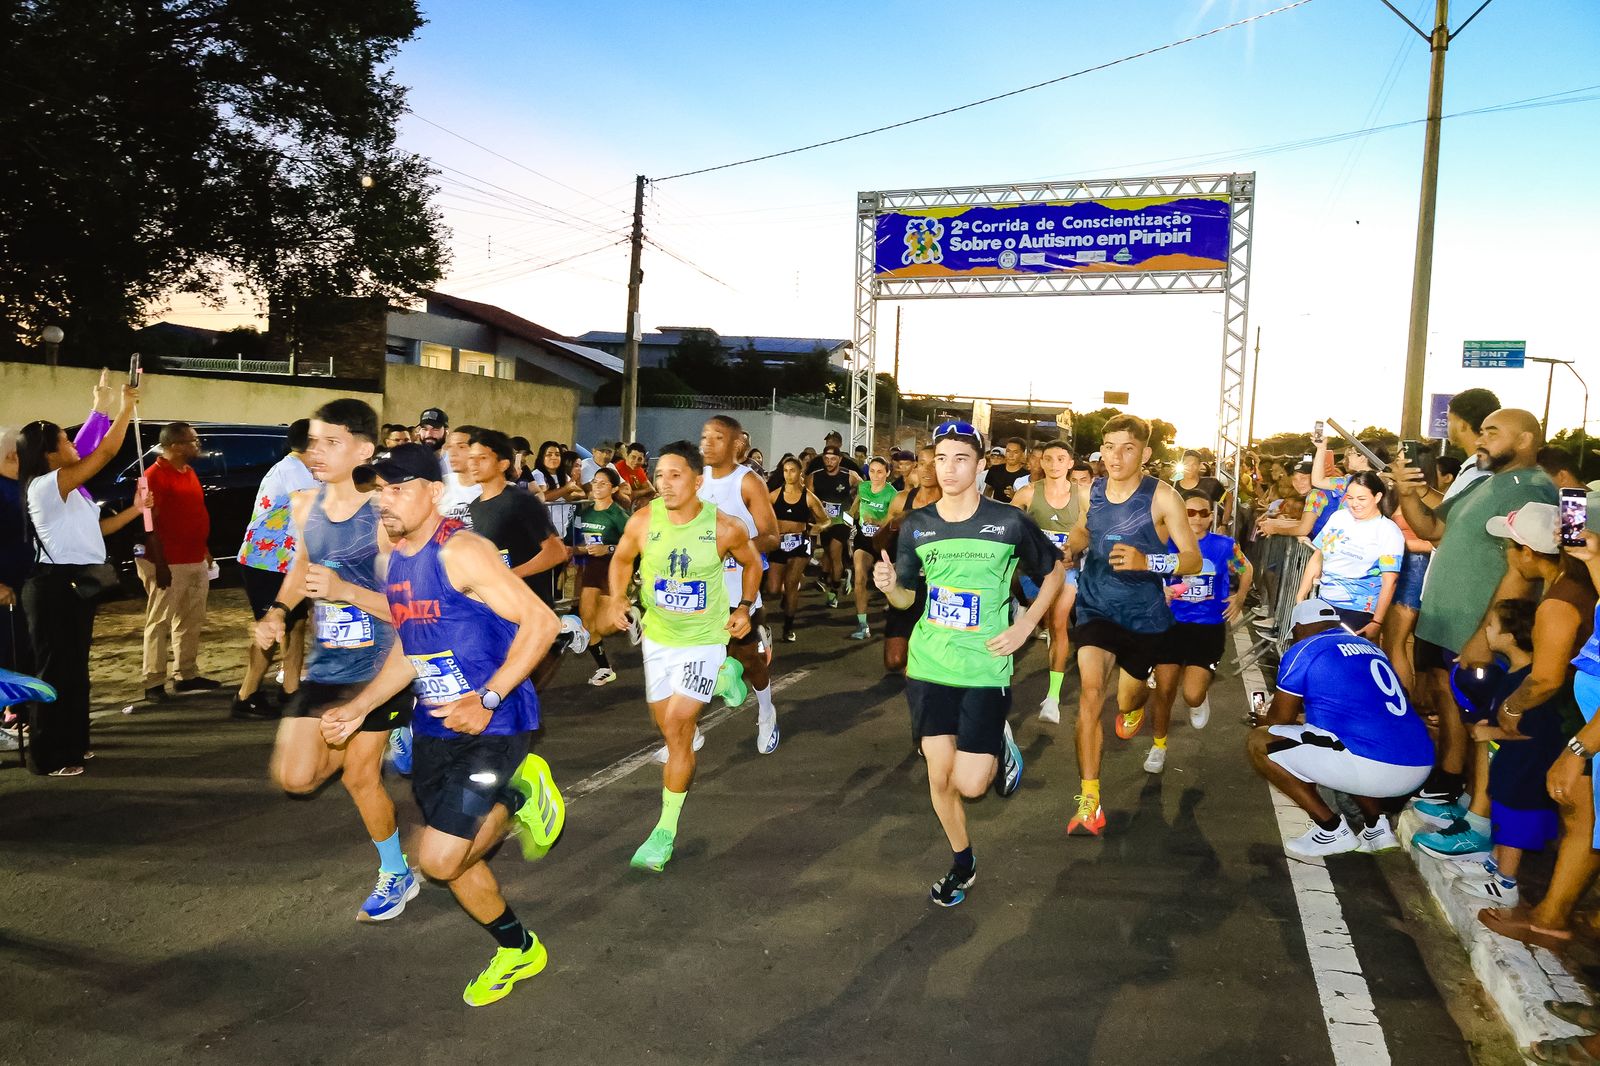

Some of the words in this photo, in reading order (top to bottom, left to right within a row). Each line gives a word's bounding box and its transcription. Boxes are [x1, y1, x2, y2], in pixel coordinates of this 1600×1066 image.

[971, 218, 1029, 233] Corrida
[1036, 217, 1055, 230] de
[1062, 211, 1192, 229] Conscientização
[949, 236, 1002, 252] Sobre
[1004, 238, 1016, 250] o
[1018, 233, 1095, 249] Autismo
[1096, 233, 1127, 246] em
[1129, 228, 1192, 247] Piripiri
[938, 550, 996, 560] FARMAFÓRMULA
[664, 593, 690, 607] 017
[698, 582, 706, 608] ADULTO
[936, 602, 961, 620] 154
[970, 595, 979, 625] ADULTO
[446, 657, 471, 690] ADULTO
[683, 660, 706, 676] HIT
[681, 671, 713, 696] HARD
[1370, 658, 1407, 716] 9
